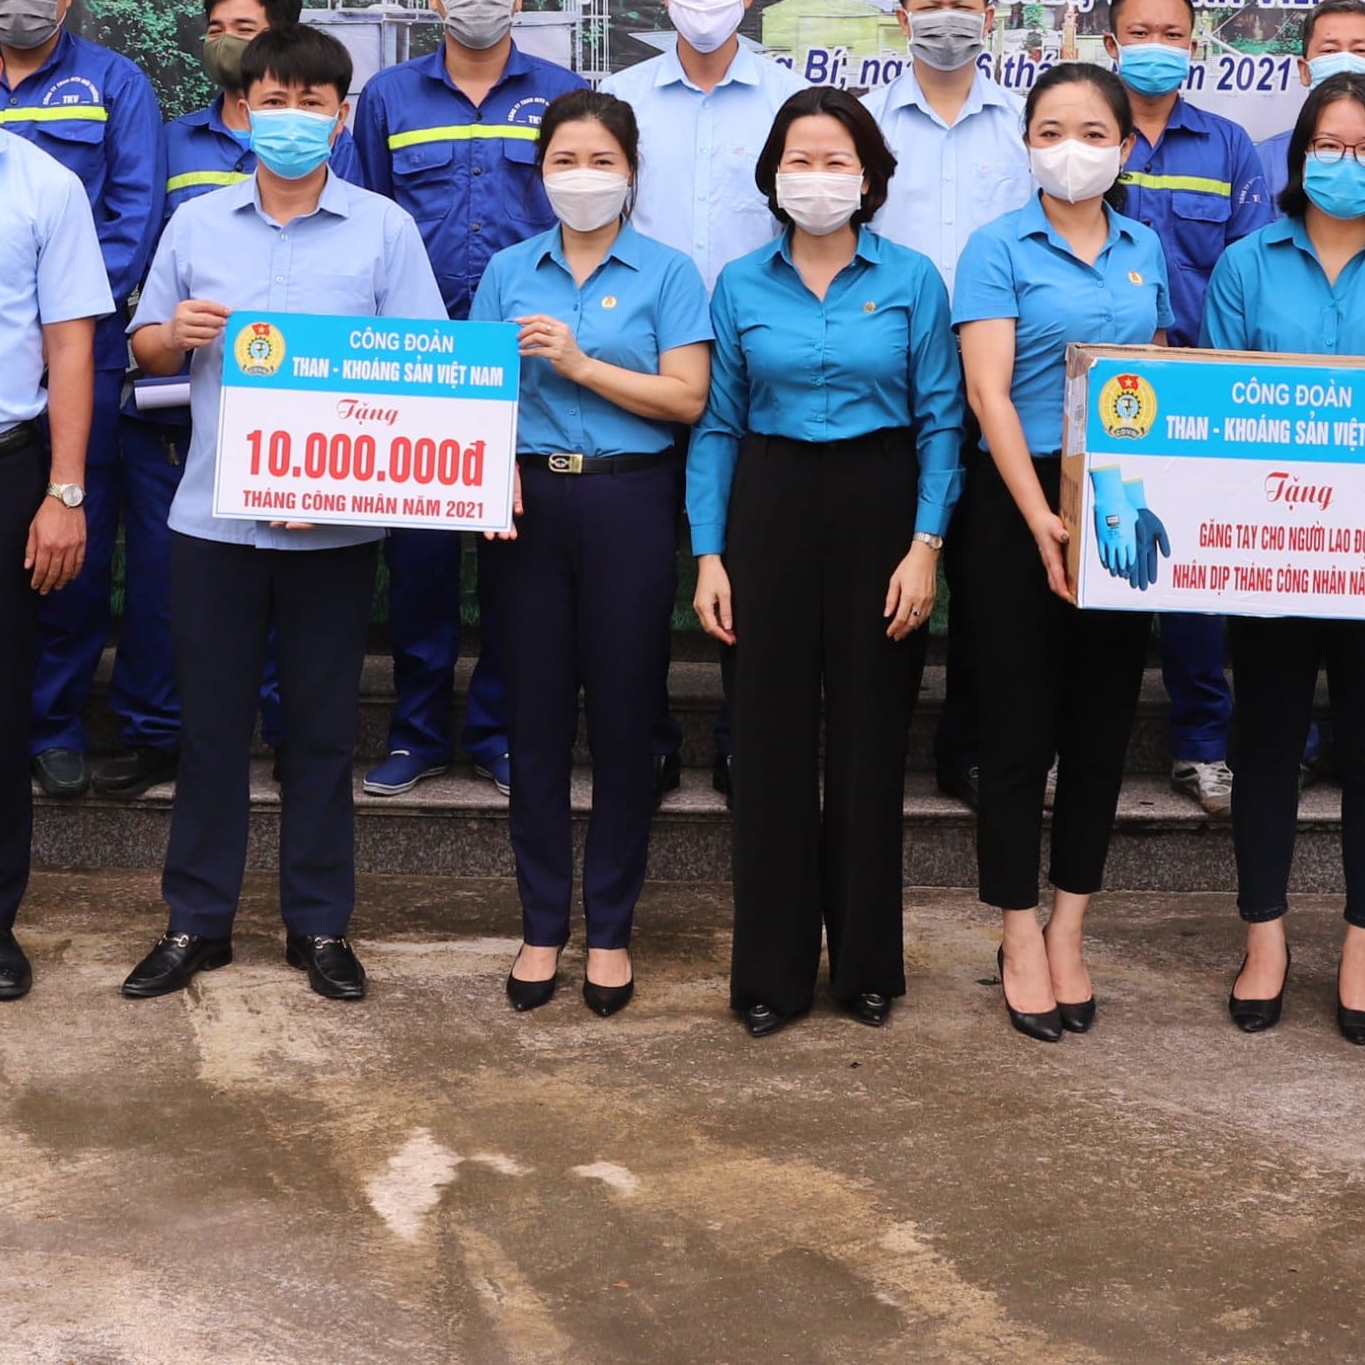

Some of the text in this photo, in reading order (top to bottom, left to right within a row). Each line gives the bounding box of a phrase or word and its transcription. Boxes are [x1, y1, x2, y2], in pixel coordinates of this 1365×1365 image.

[804, 49, 847, 89] Bí,
[1216, 56, 1292, 91] 2021
[349, 327, 454, 353] CÔNG ĐOÀN
[292, 357, 329, 379] THAN
[342, 357, 400, 382] KHOÁNG
[404, 355, 433, 384] SẢN
[437, 364, 467, 389] VIỆT
[470, 367, 504, 387] NAM
[1231, 377, 1353, 409] CÔNG ĐOÀN
[337, 398, 400, 426] Tặng
[1166, 415, 1210, 440] THAN
[1224, 414, 1291, 444] KHOÁNG
[1295, 411, 1329, 446] SẢN
[246, 429, 487, 488] 10.000.000đ
[243, 488, 484, 519] THÁNG CÔNG NHÂN NĂM 2021
[1264, 471, 1334, 511] Tặng
[1199, 517, 1232, 549] GĂNG
[1236, 524, 1258, 550] TAY
[1261, 525, 1285, 551] CHO
[1288, 522, 1325, 553] NGƯỜI
[1328, 527, 1351, 554] LAO
[1172, 558, 1208, 589] NHÂN
[1210, 565, 1231, 596] DỊP
[1233, 563, 1273, 592] THÁNG
[1276, 564, 1309, 594] CÔNG
[1312, 565, 1346, 596] NHÂN
